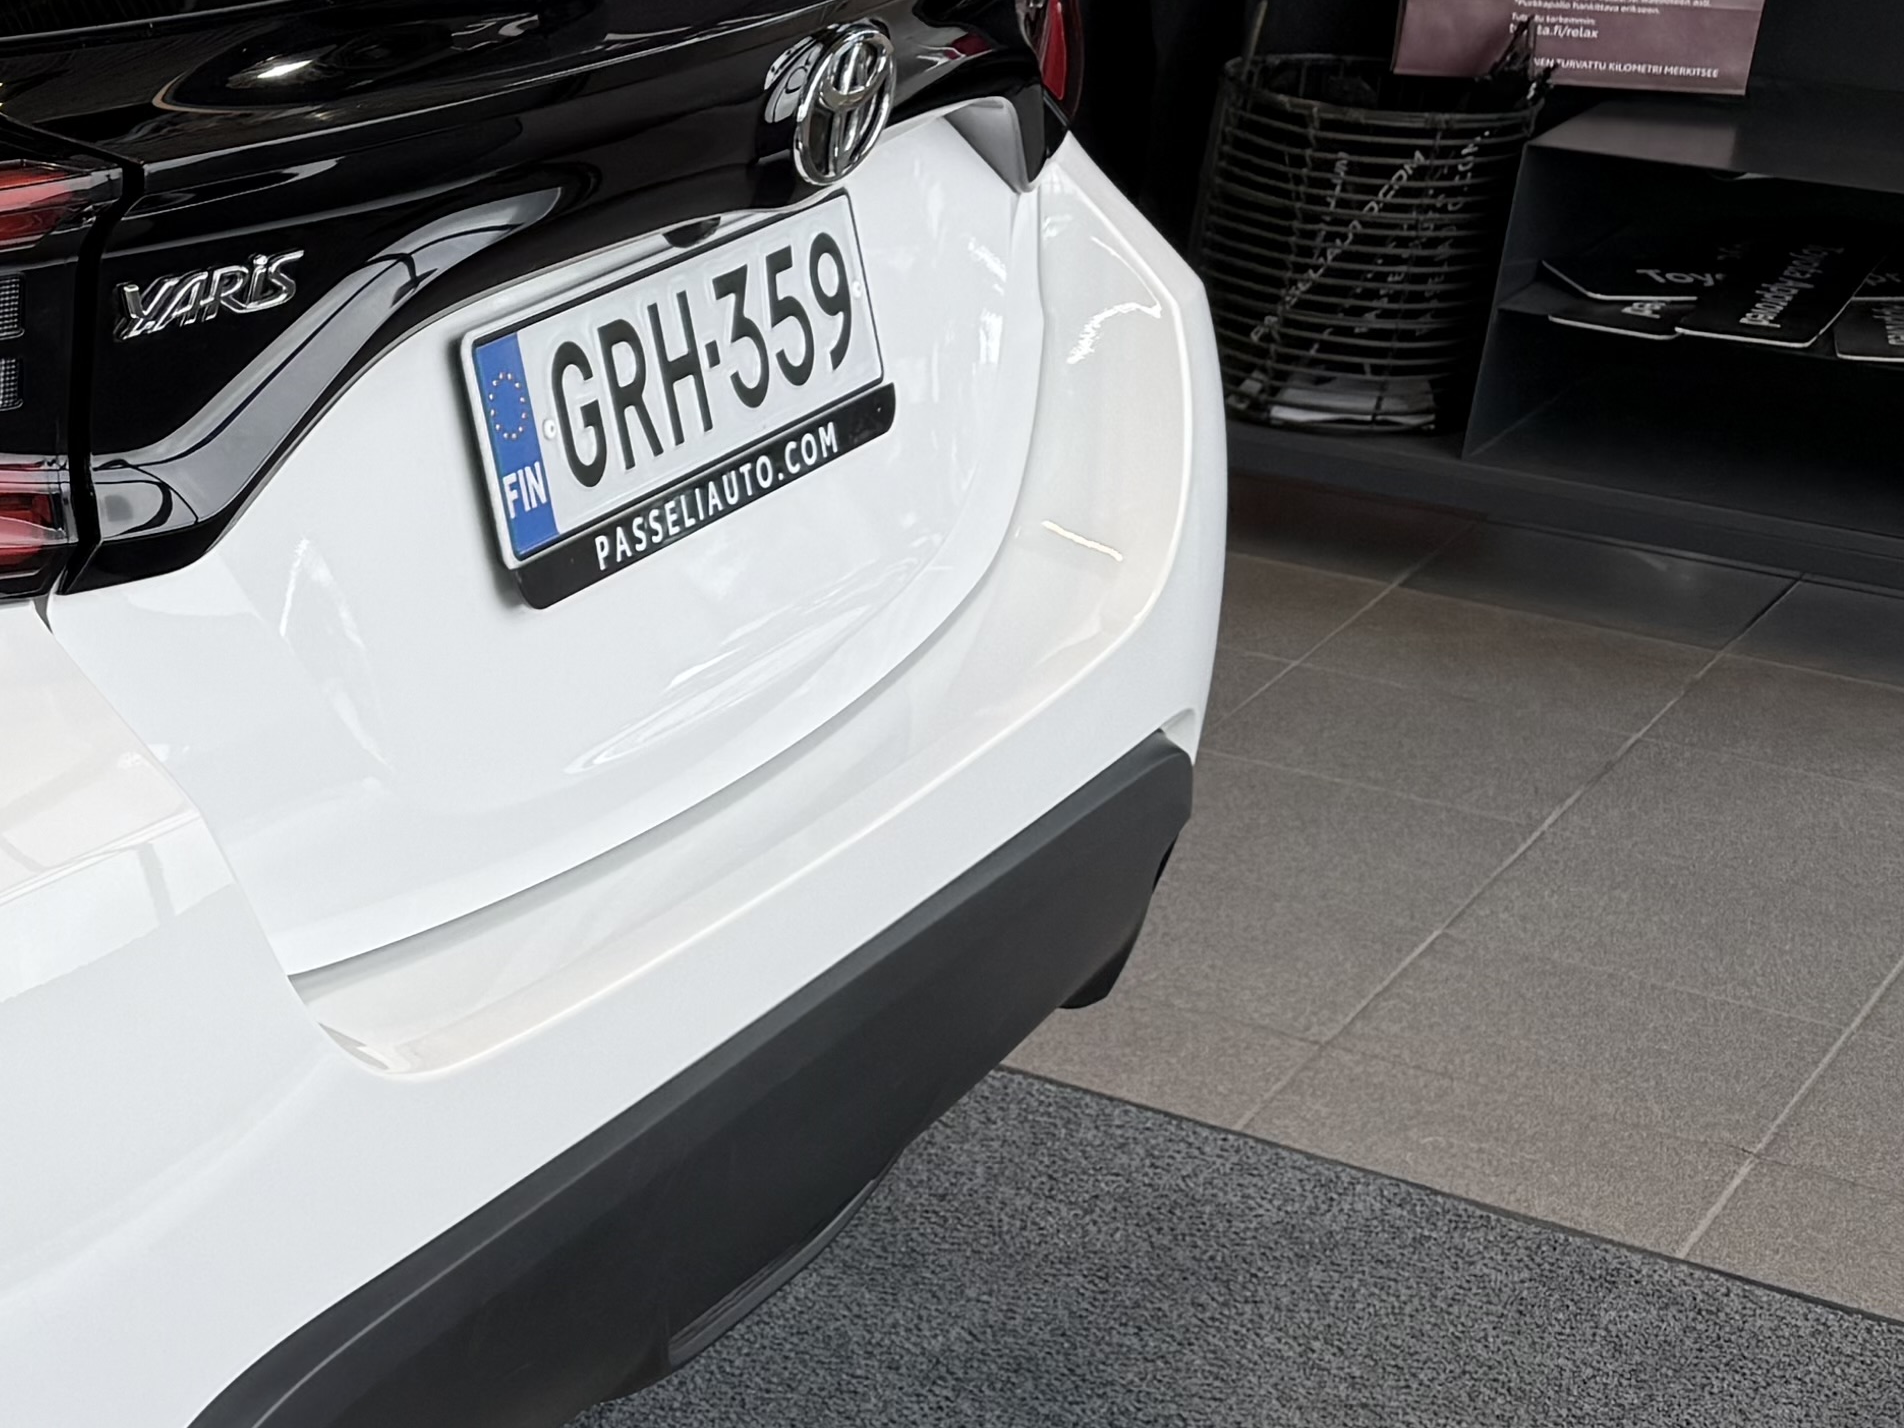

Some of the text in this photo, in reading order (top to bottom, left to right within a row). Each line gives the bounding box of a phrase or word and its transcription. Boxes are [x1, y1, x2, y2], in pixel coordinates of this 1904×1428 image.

[549, 232, 853, 490] GRH-359
[502, 459, 551, 520] FIN
[594, 424, 840, 573] PASSELIAUTO.COM
